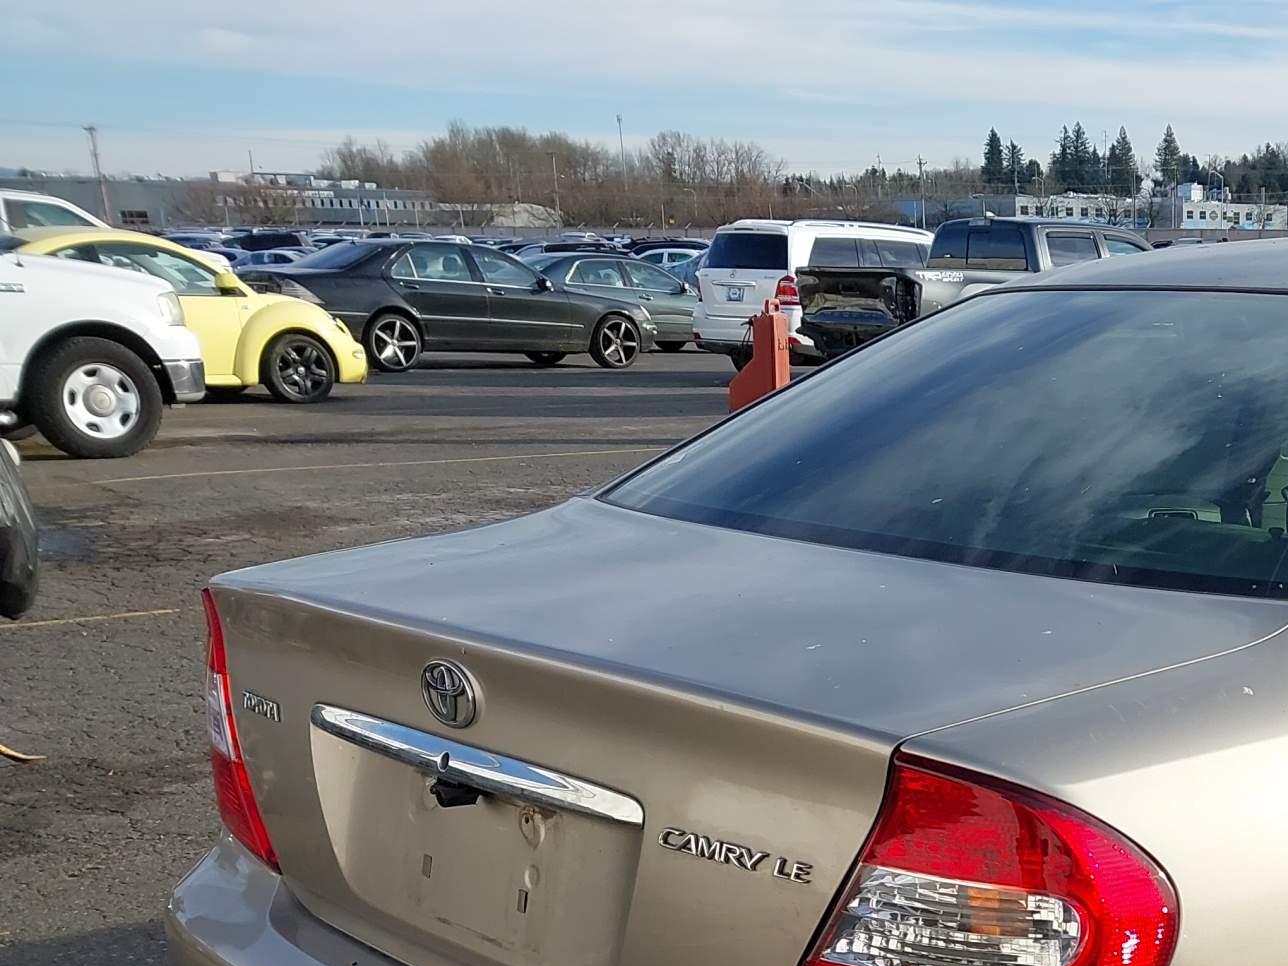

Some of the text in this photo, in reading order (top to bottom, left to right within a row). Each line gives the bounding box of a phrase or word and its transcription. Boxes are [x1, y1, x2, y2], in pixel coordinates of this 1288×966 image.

[241, 689, 281, 723] TOYOTA
[658, 826, 814, 885] CAMRY LE
